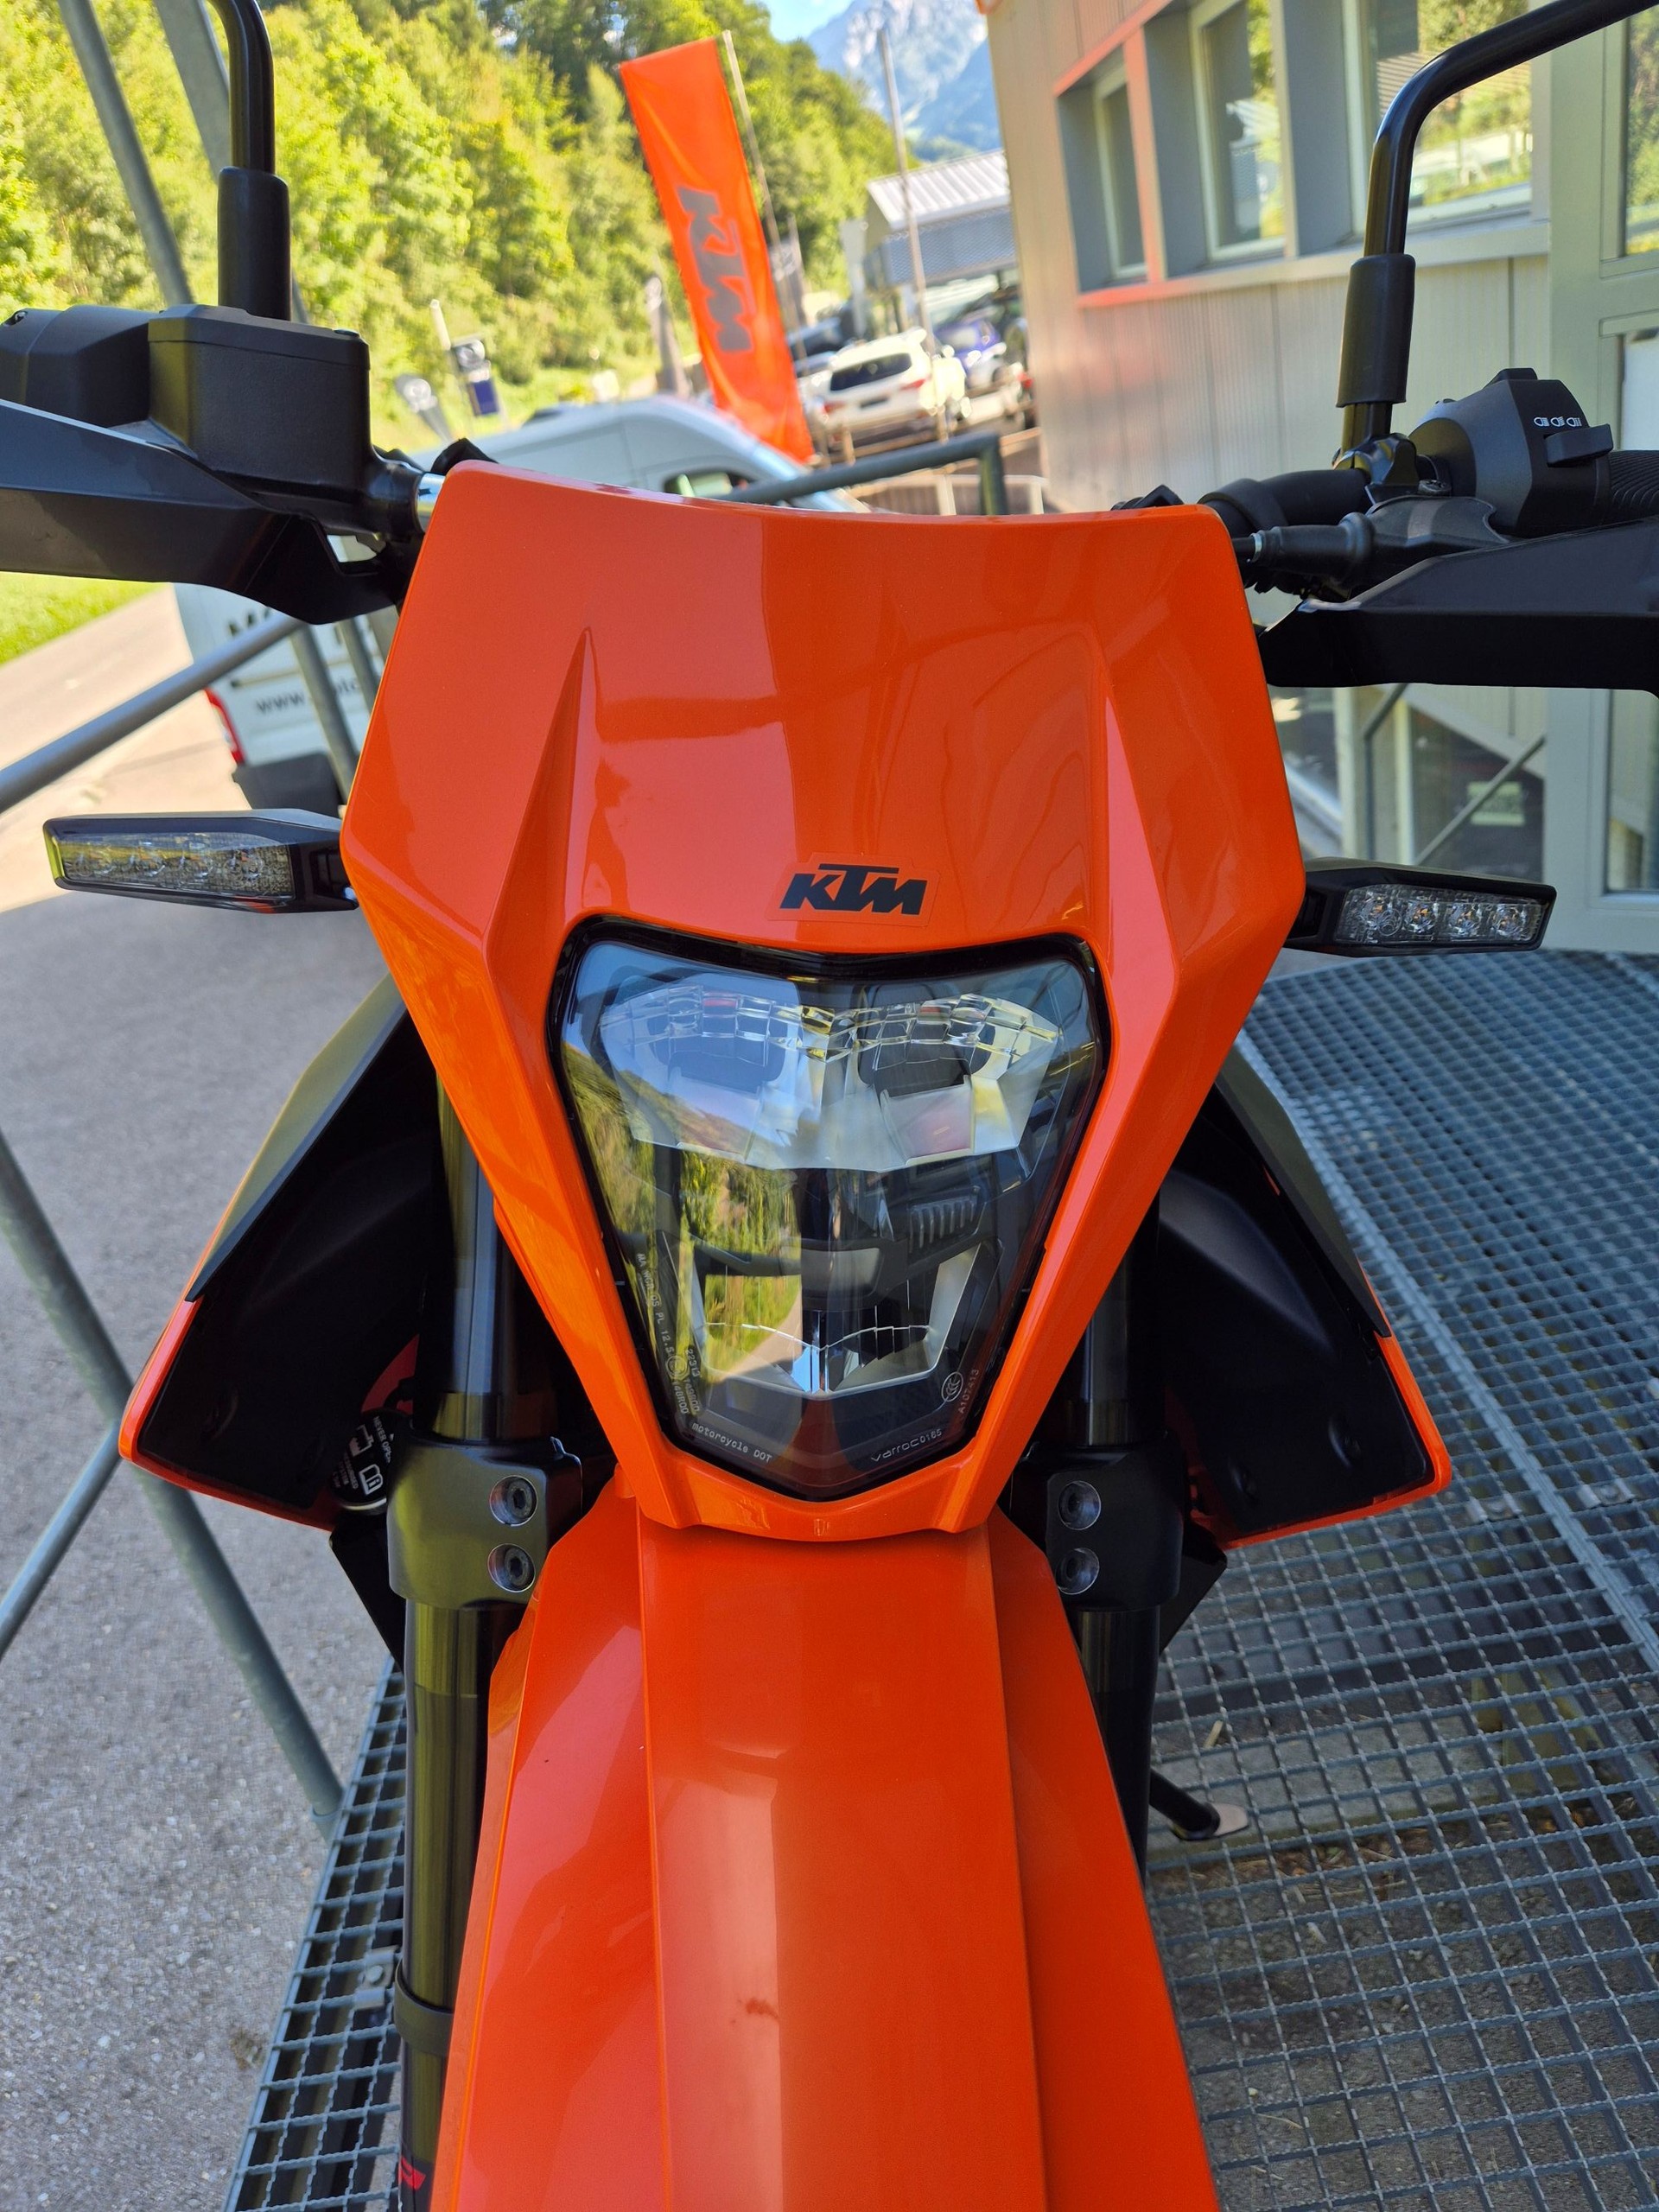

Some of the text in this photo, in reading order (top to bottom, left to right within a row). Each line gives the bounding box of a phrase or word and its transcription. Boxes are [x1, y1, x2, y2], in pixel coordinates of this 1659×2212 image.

[677, 185, 754, 352] KTM
[779, 863, 928, 916] KTM
[691, 1422, 772, 1464] motorcycle DOT
